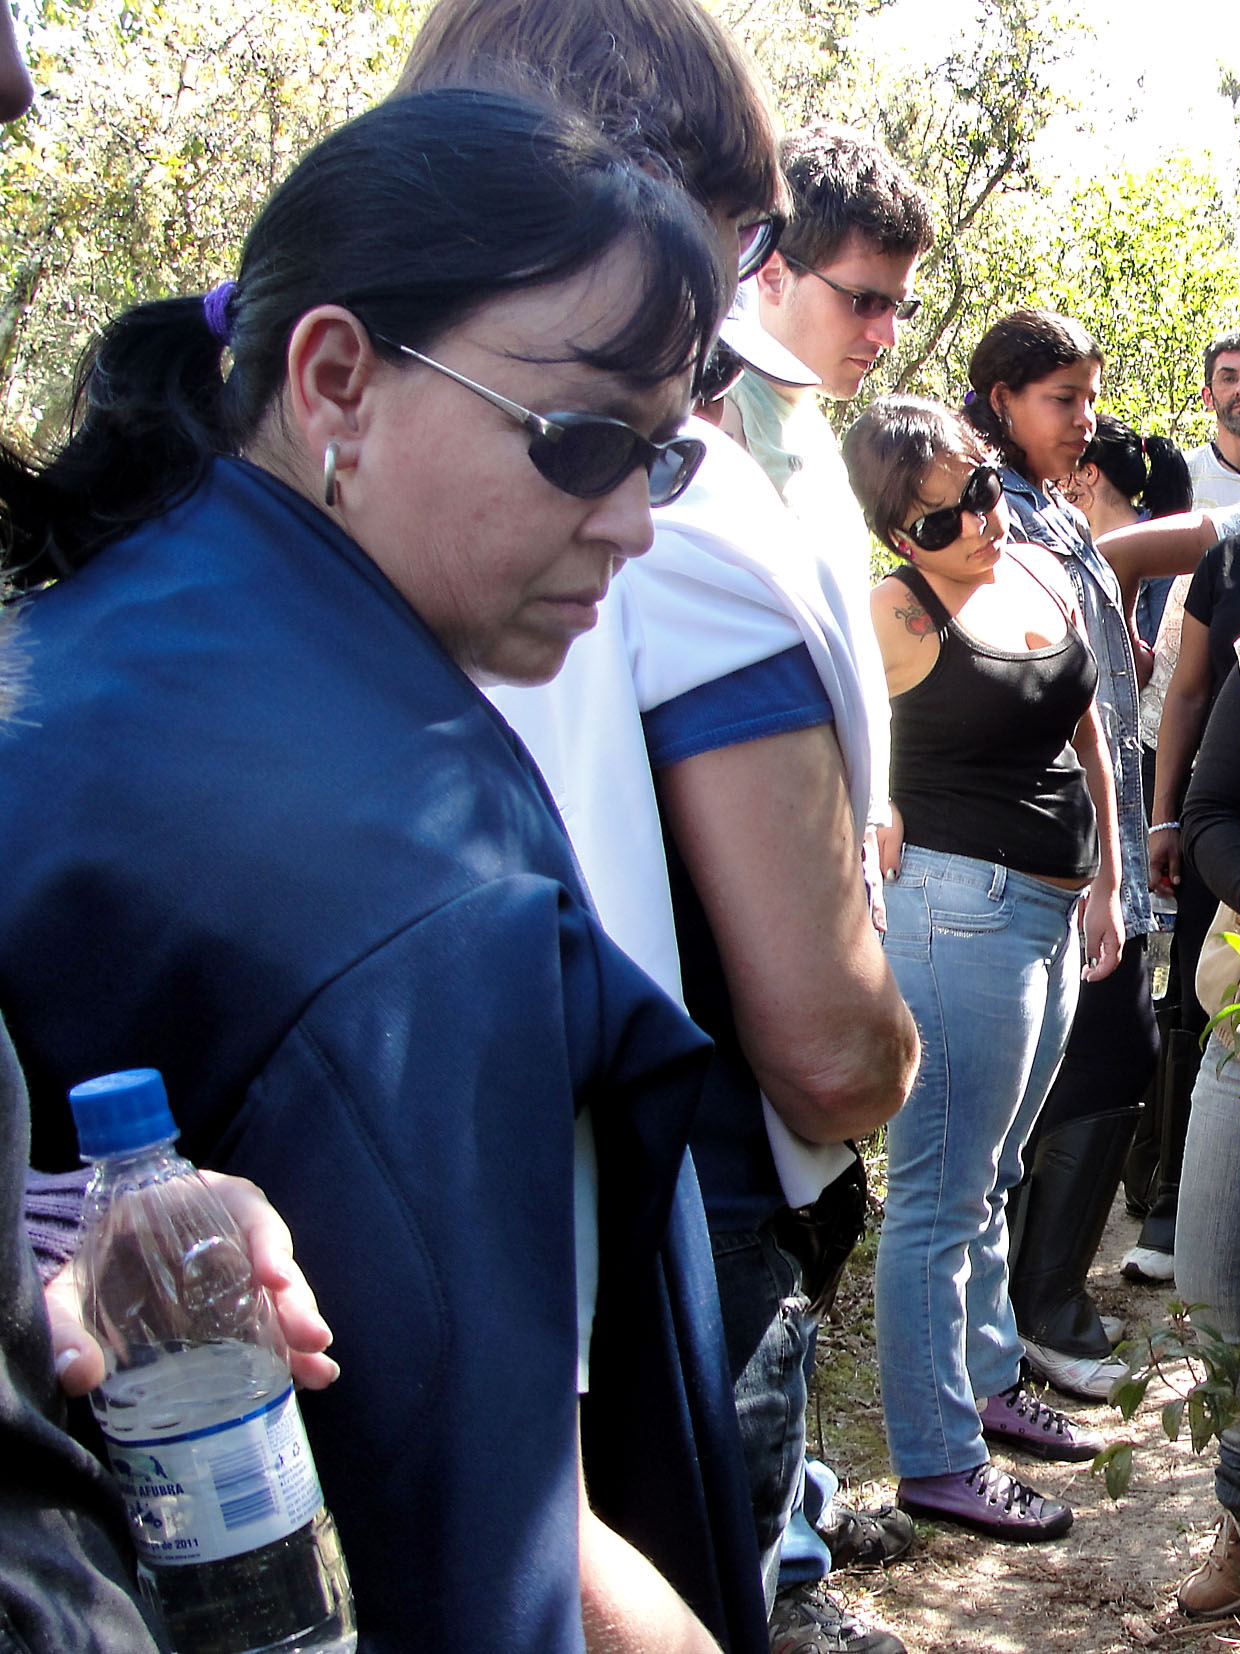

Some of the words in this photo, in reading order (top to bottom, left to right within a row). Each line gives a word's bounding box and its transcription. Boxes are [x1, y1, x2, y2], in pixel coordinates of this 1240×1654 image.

[139, 1483, 184, 1497] AFUBRA
[162, 1539, 173, 1549] de
[175, 1538, 199, 1549] 2011
